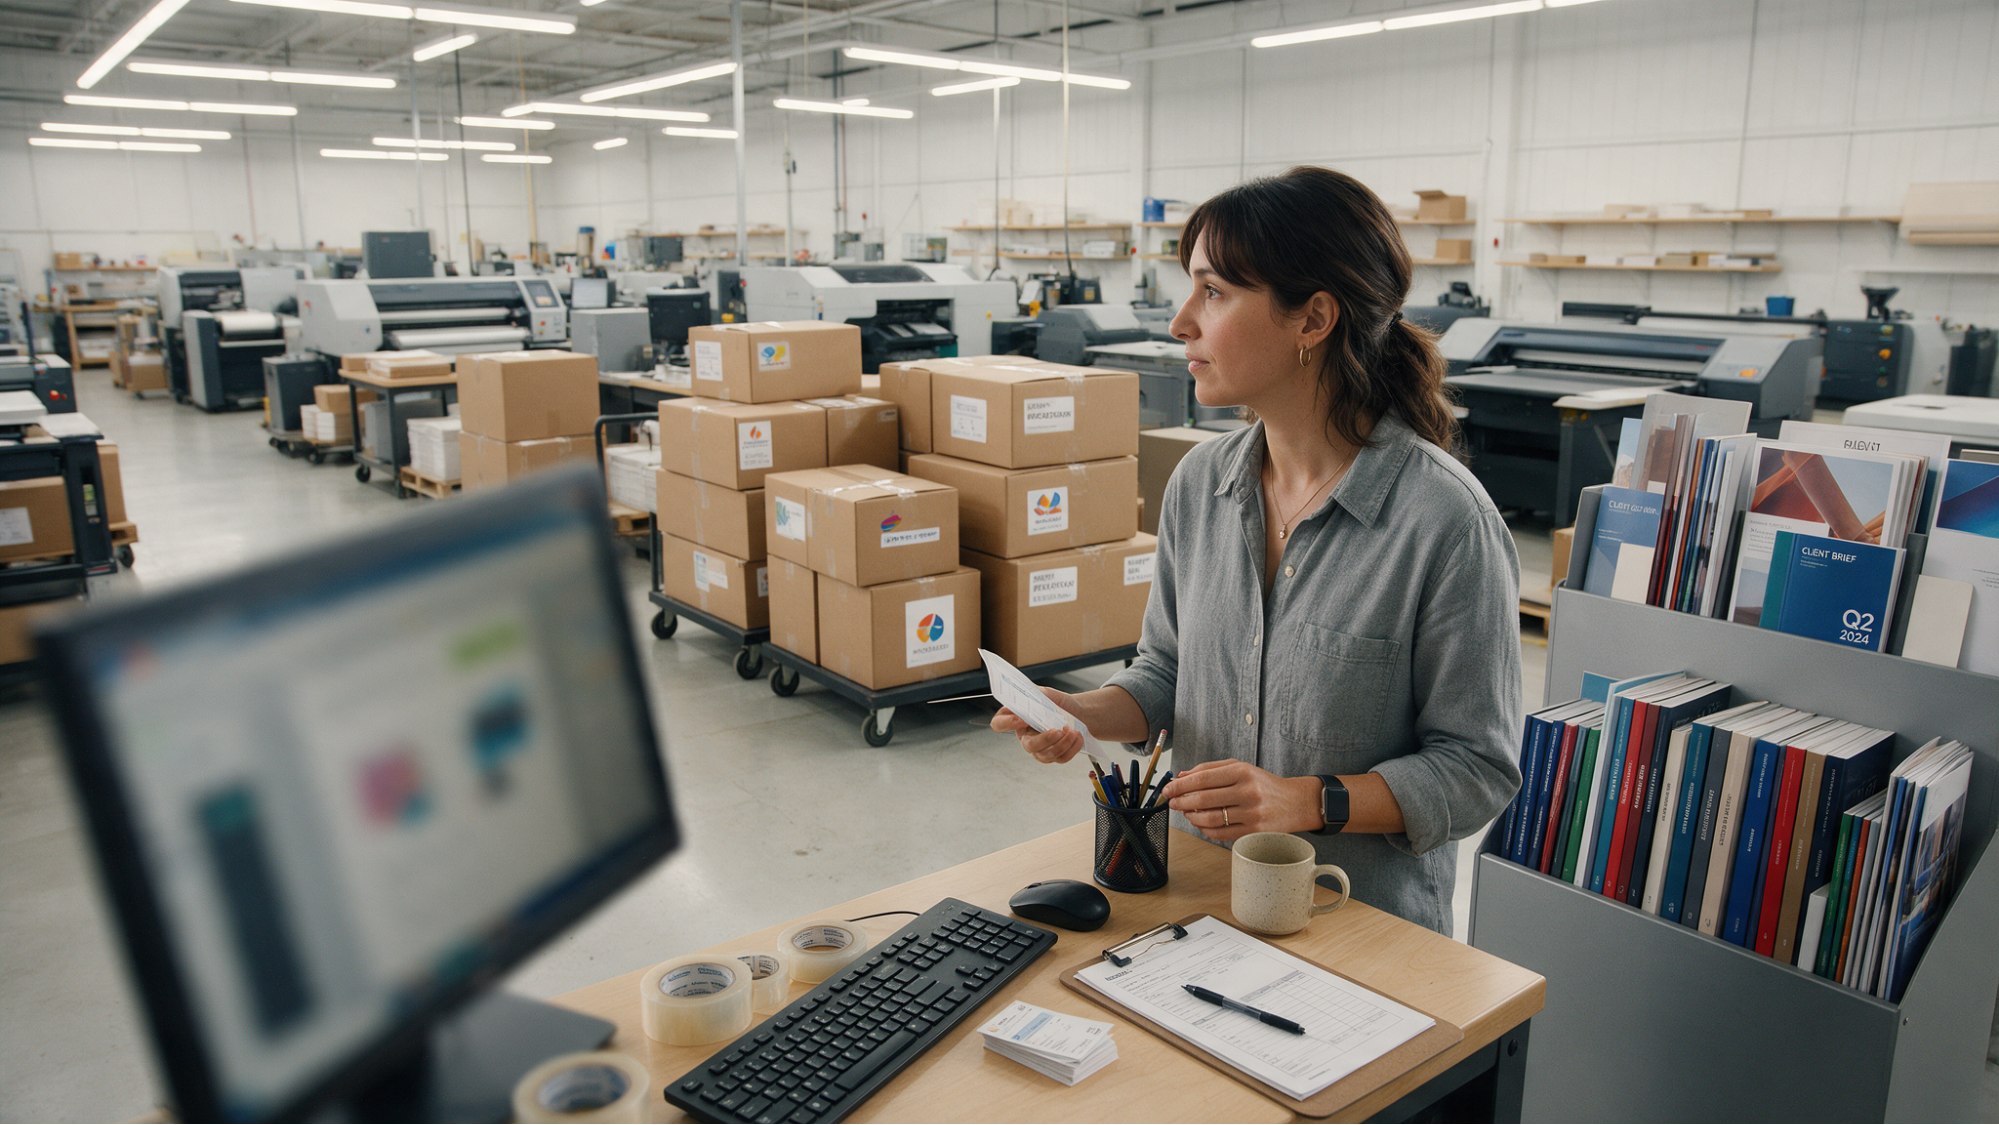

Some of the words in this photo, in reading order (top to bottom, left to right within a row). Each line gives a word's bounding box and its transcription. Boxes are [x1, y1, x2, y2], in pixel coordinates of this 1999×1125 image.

[1831, 551, 1857, 563] BRIEF
[1842, 609, 1875, 632] Q2
[1839, 629, 1869, 645] 2024
